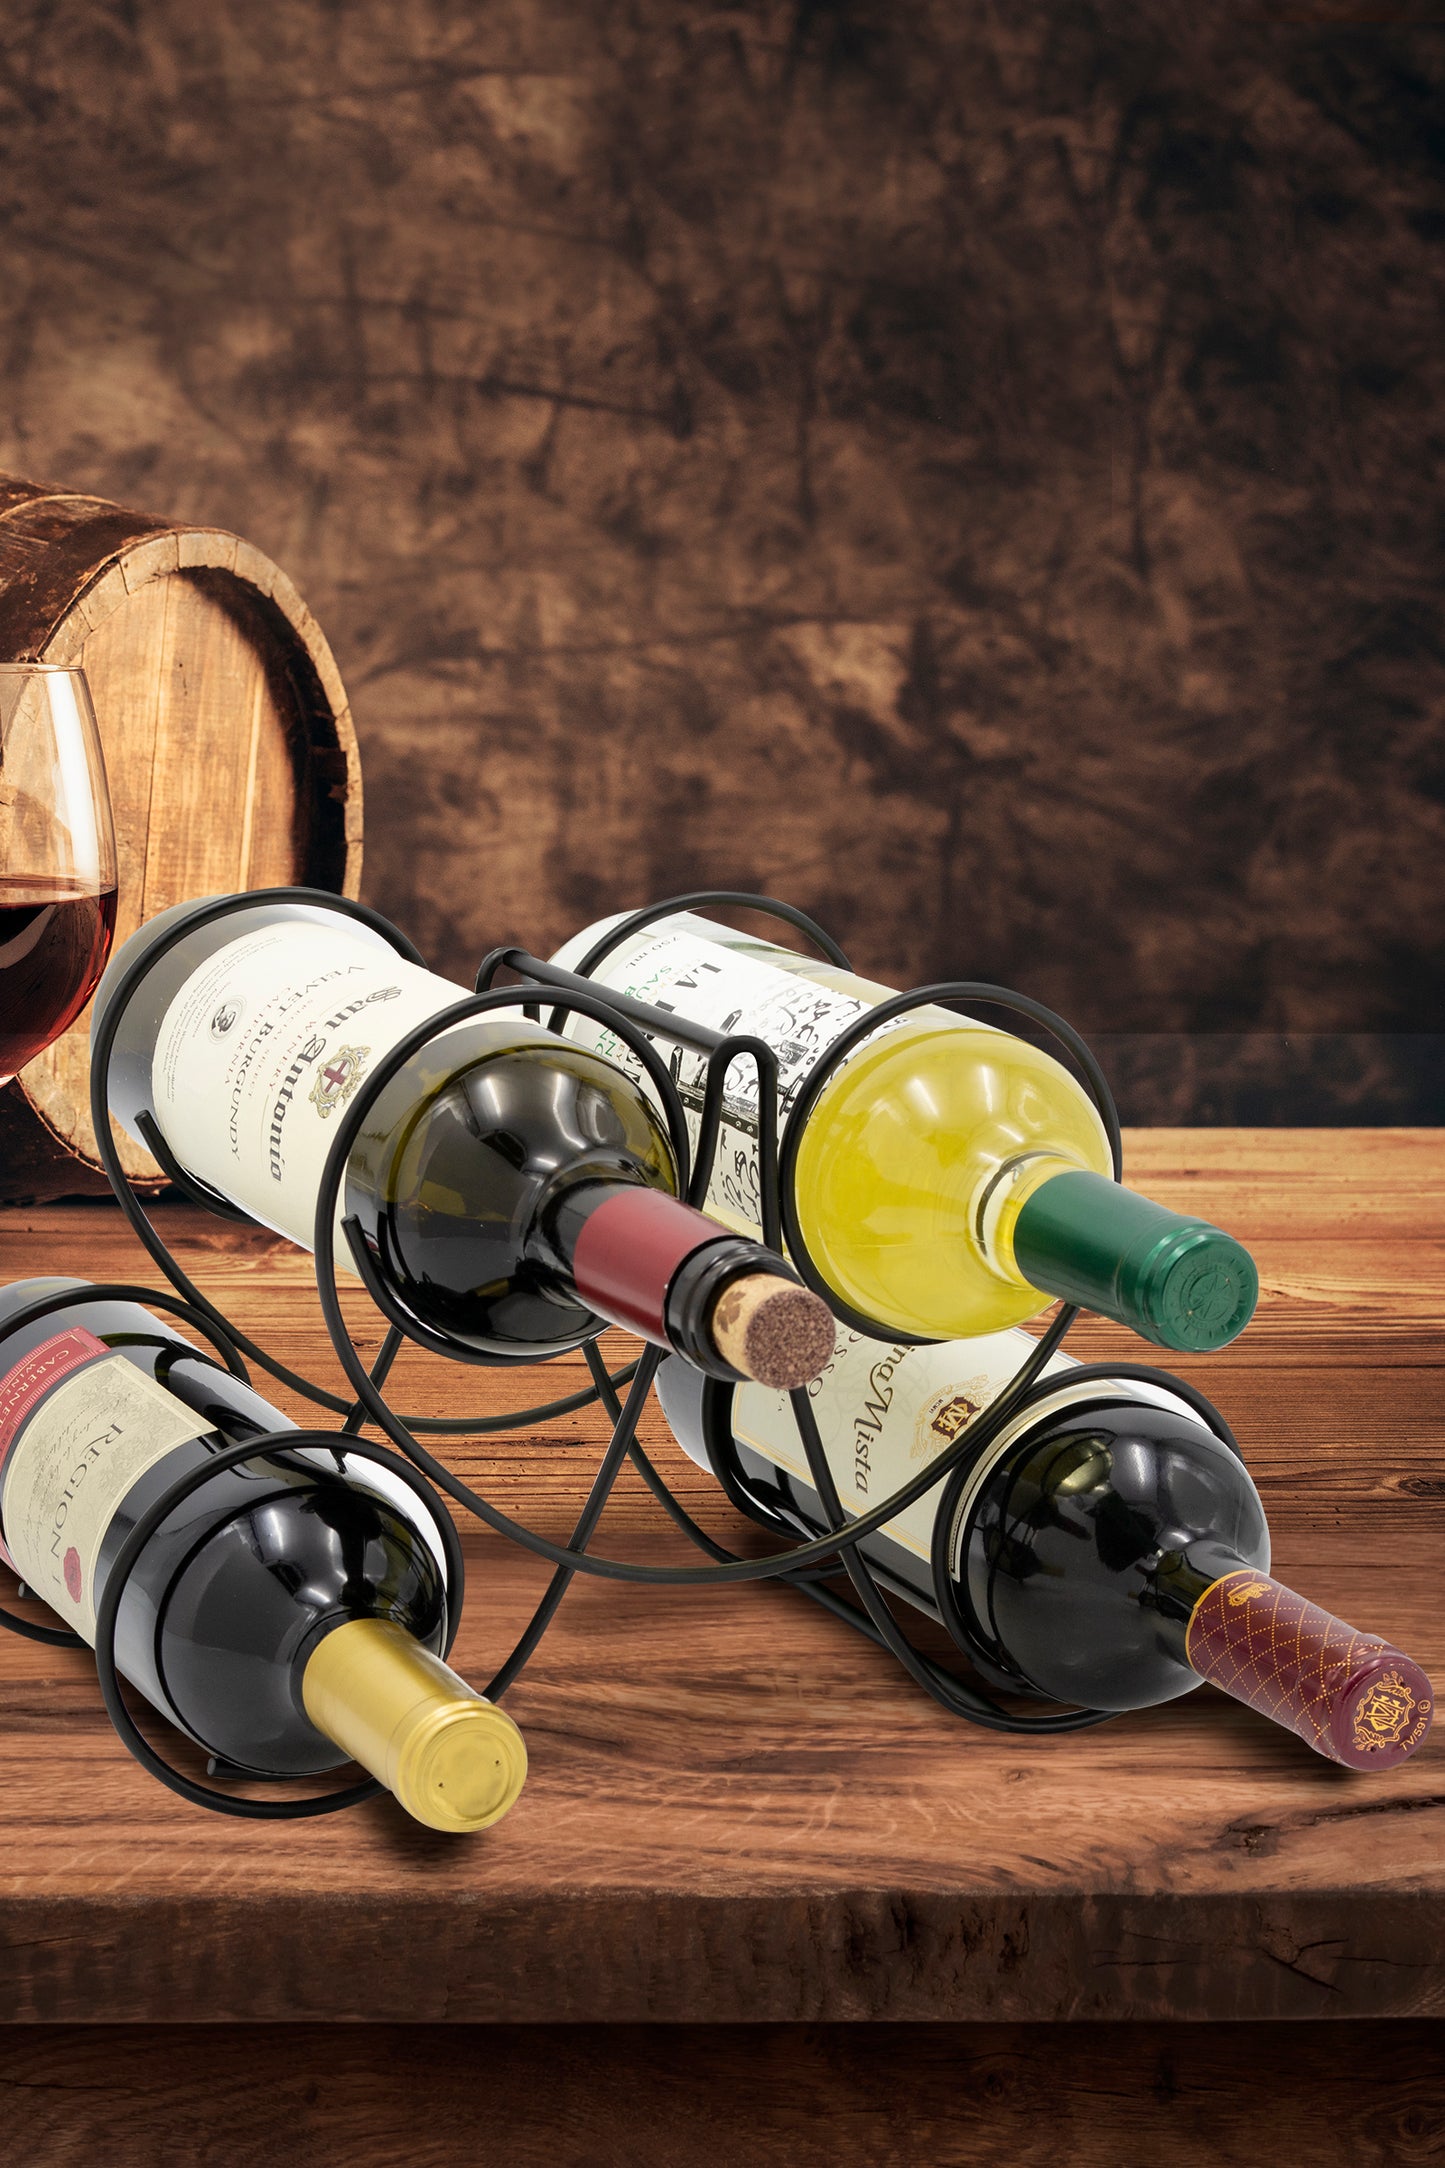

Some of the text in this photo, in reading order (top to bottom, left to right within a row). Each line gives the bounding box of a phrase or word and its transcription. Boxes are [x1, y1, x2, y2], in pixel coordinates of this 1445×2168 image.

[279, 966, 365, 1017] VELVET
[224, 986, 291, 1084] CALIFORNIA
[269, 1020, 317, 1091] WINERY
[229, 1021, 274, 1161] BURGUNDY
[269, 986, 403, 1182] San Antonio
[5, 1362, 36, 1395] WINE
[50, 1423, 125, 1559] REGION
[1400, 1716, 1428, 1752] TV/591
